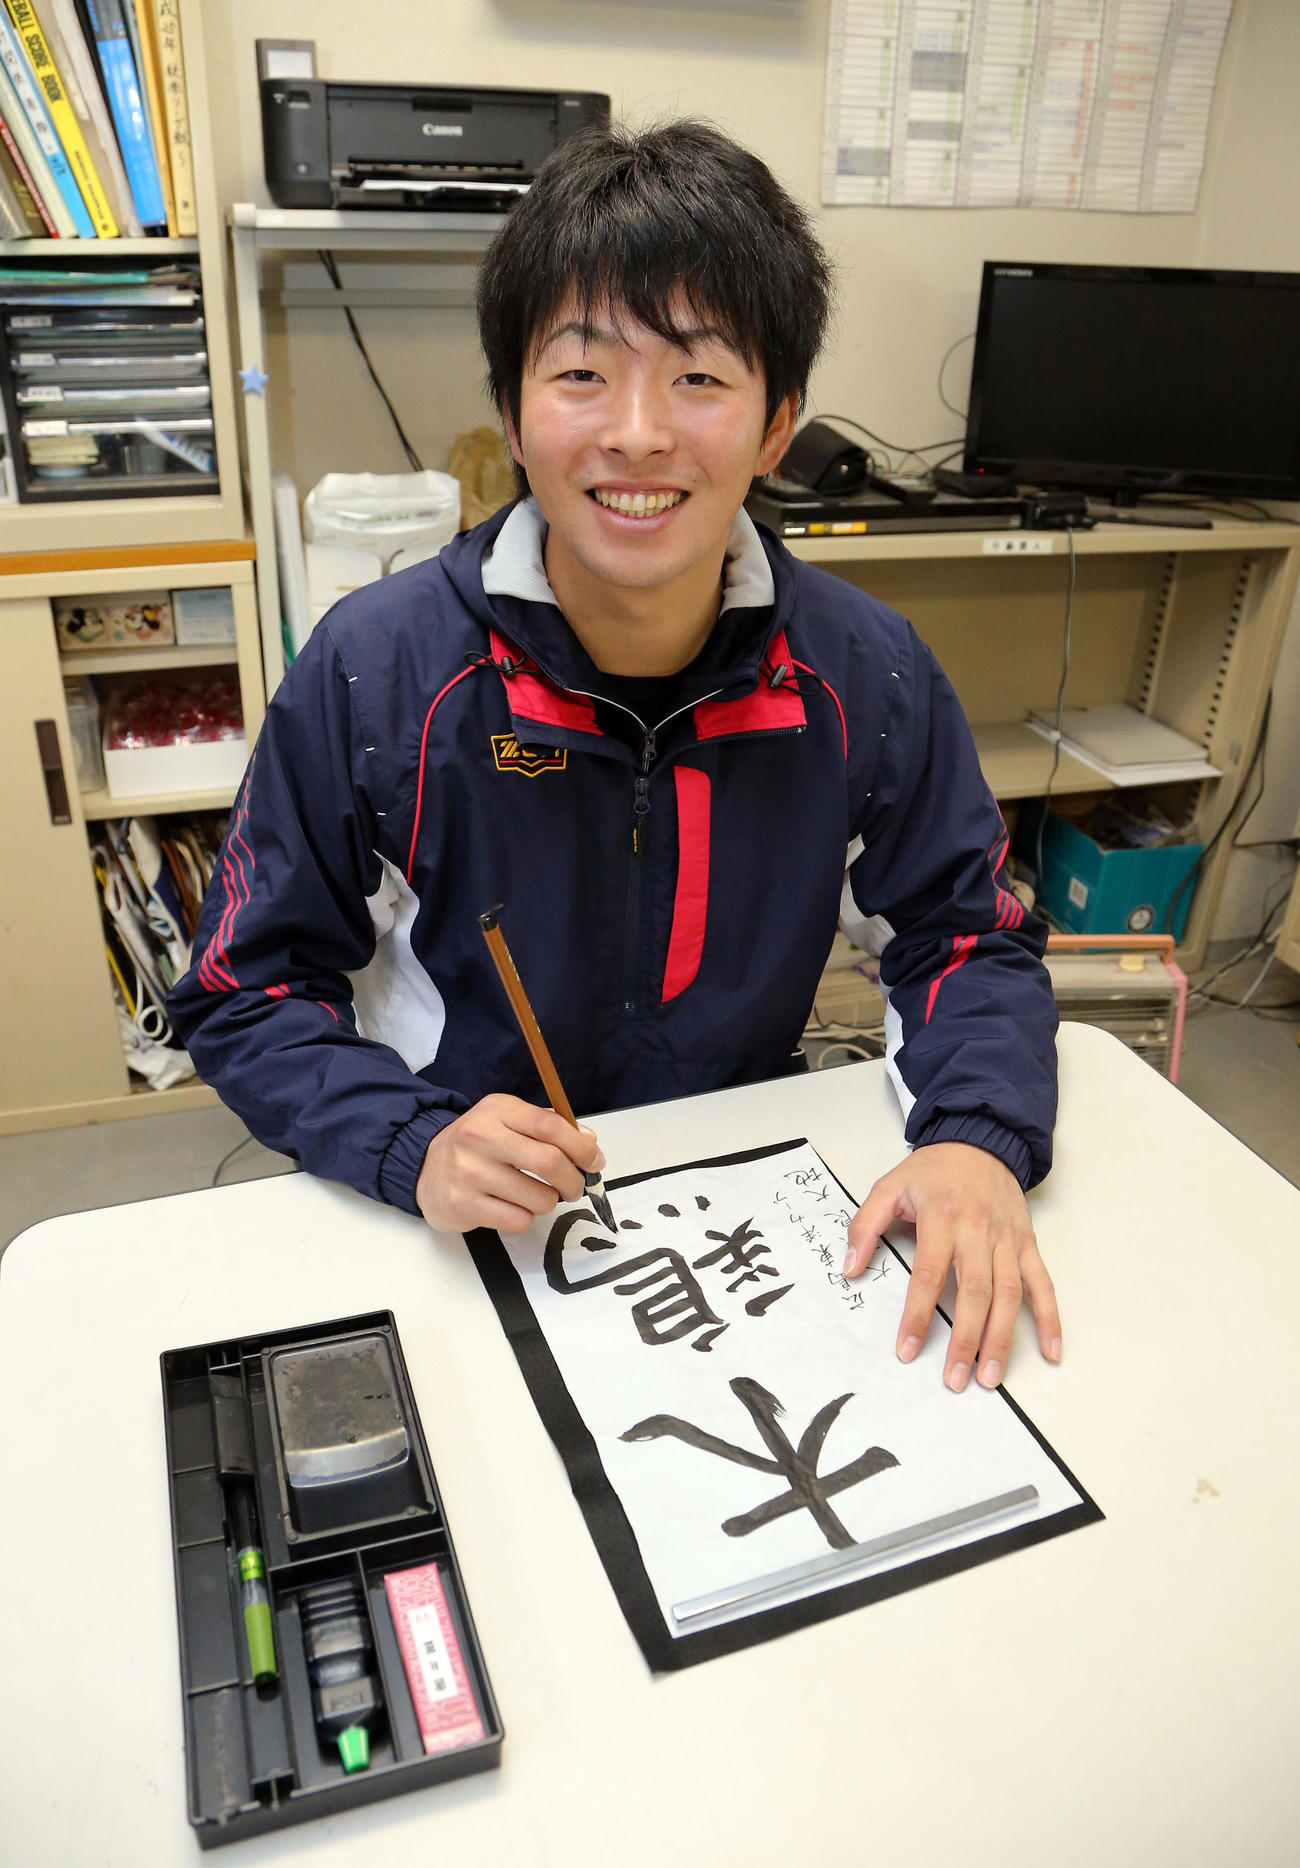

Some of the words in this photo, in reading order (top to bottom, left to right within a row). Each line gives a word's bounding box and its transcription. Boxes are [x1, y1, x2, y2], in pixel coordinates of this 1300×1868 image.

[25, 33, 51, 68] SCORE
[41, 74, 64, 104] BOOK
[422, 122, 463, 136] Canon
[773, 1191, 864, 1310] 広島東洋カープ
